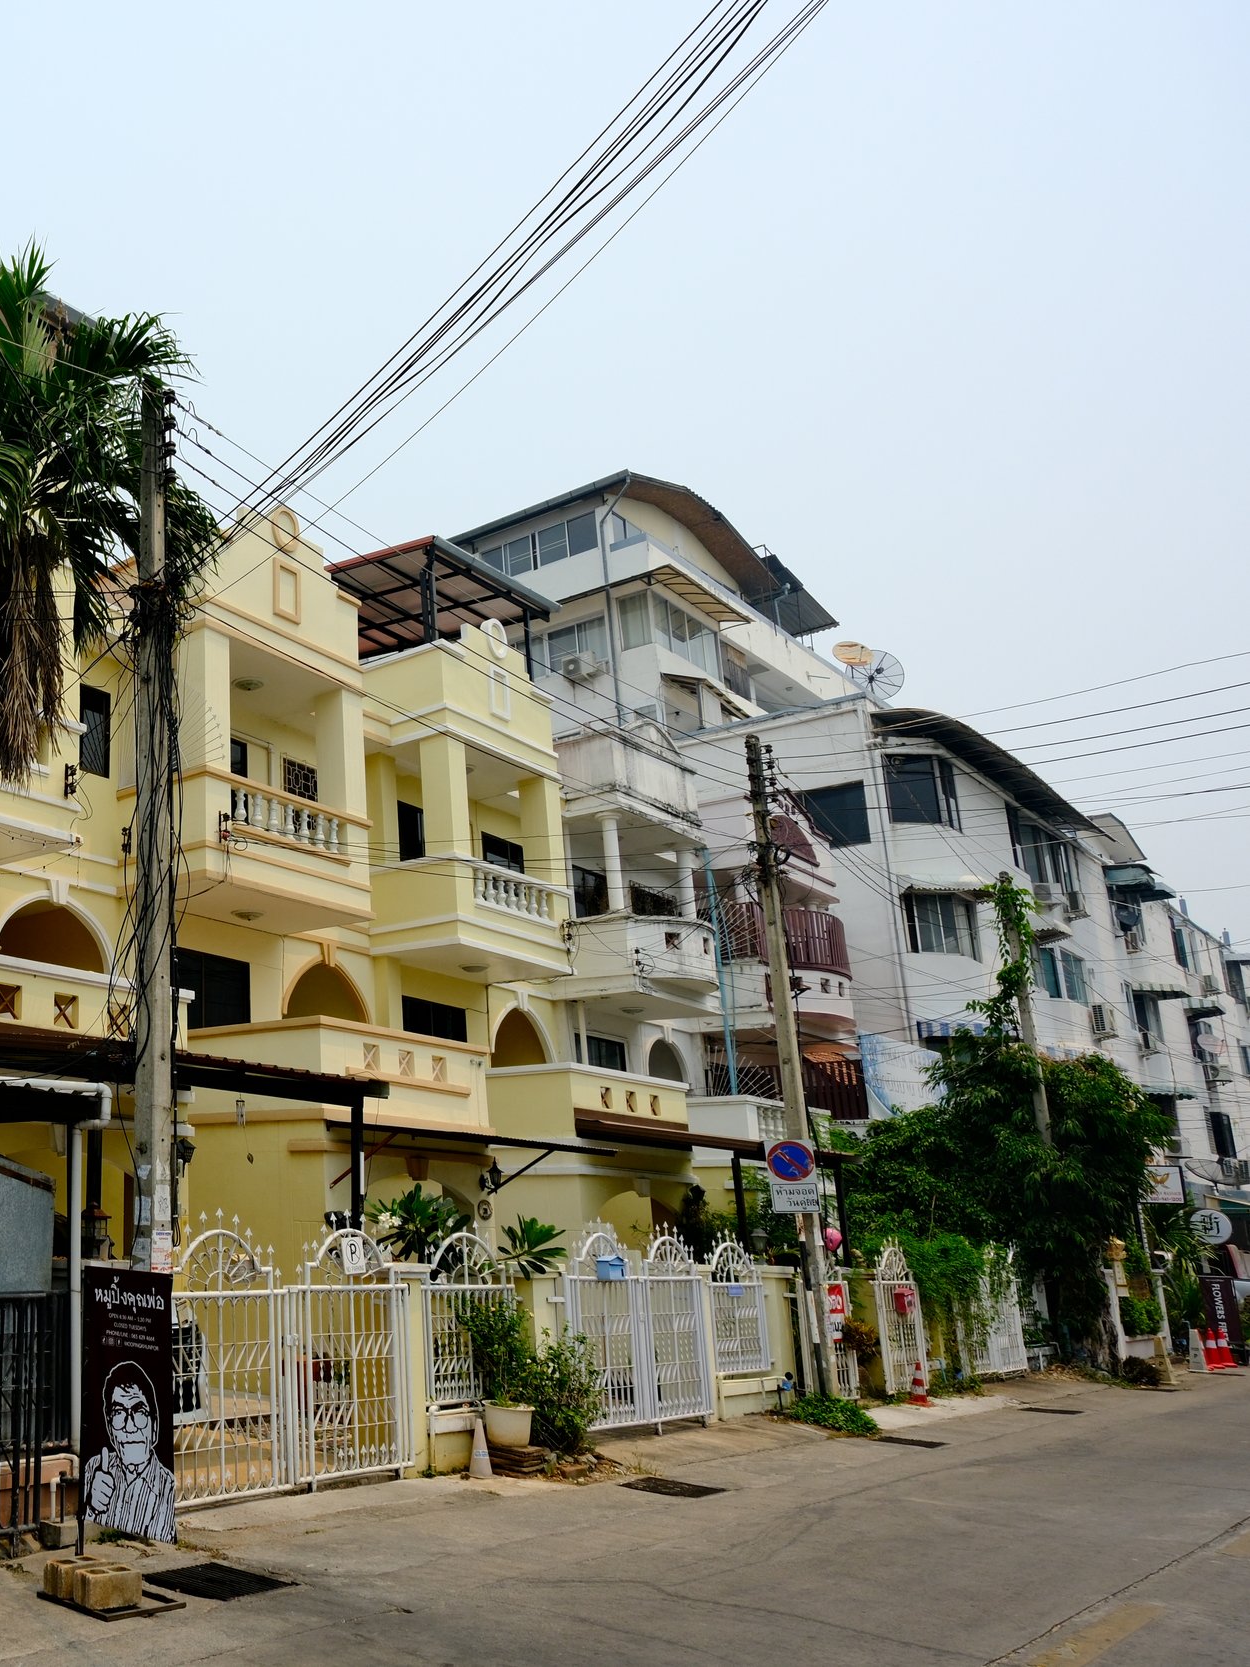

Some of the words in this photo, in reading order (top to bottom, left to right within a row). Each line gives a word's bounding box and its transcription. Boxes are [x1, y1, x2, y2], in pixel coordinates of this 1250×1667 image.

[775, 1186, 815, 1196] ห้ามจอด
[94, 1276, 165, 1314] หมูปิ้งคุณพ่อ
[1211, 1283, 1226, 1321] FLOWERS
